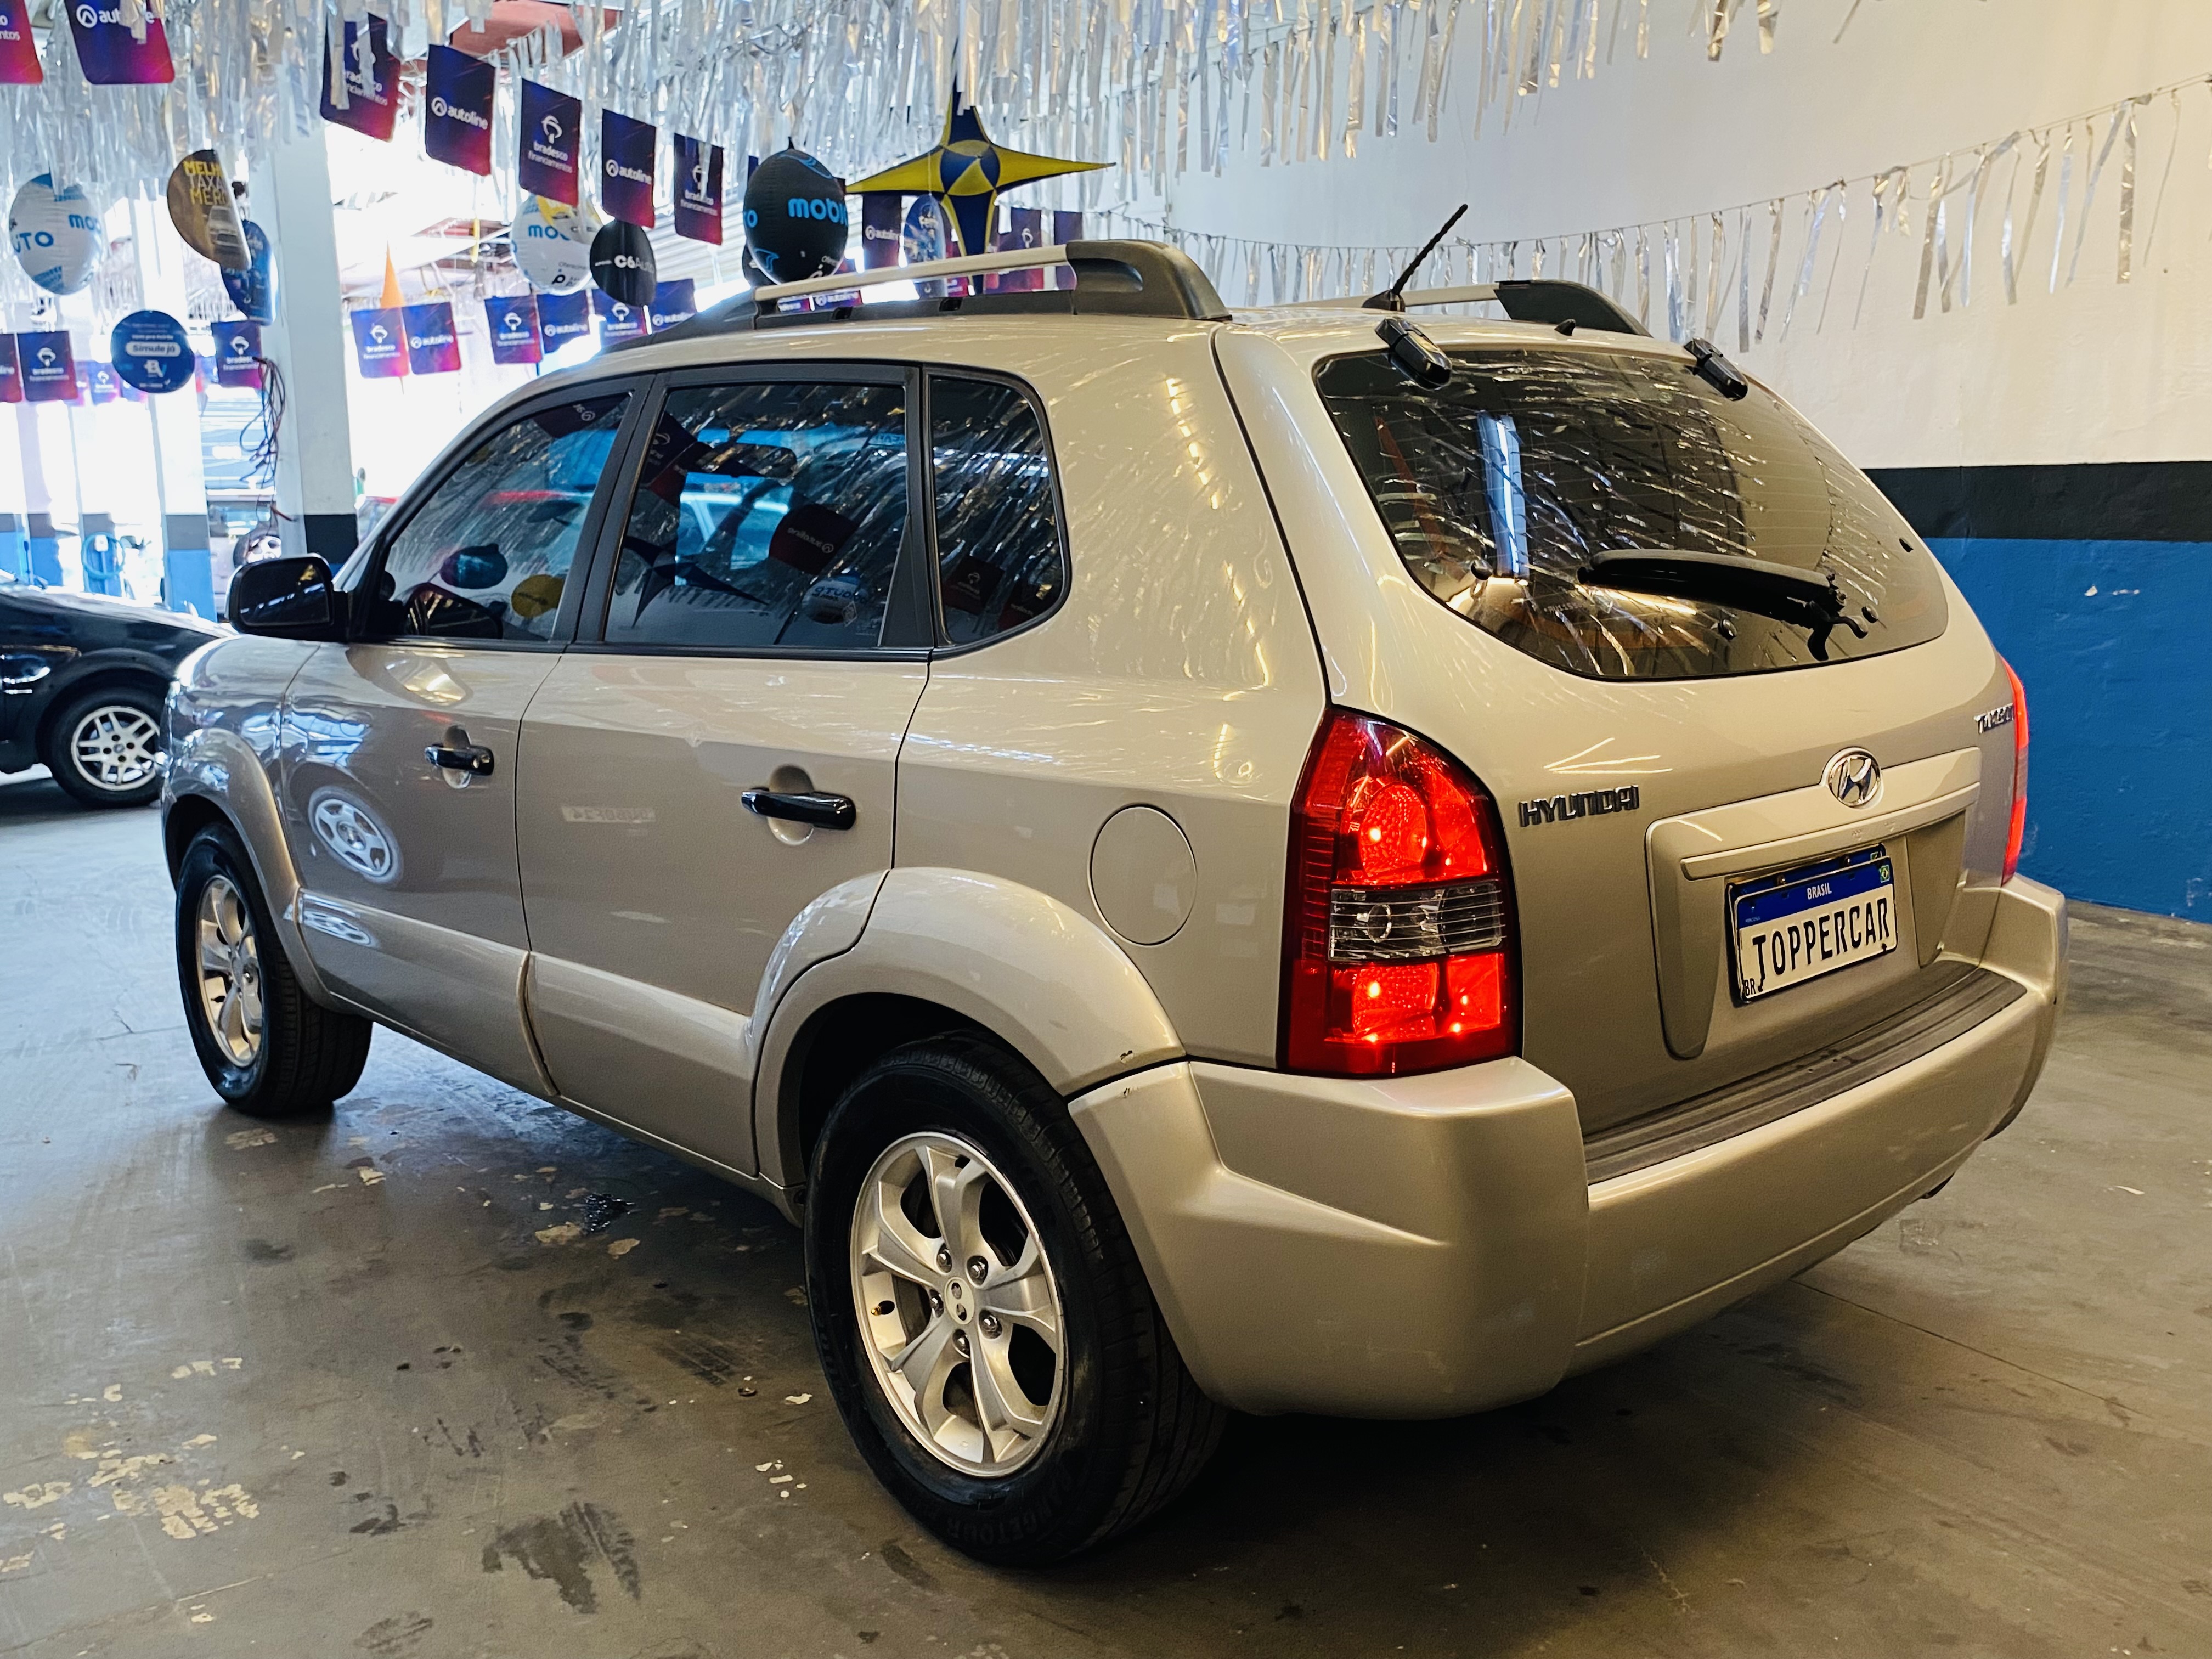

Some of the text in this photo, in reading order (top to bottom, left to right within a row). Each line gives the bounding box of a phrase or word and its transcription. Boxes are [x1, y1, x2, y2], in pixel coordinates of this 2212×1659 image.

[447, 106, 488, 130] autoline
[533, 140, 568, 161] bradesco
[619, 166, 652, 185] autoline
[1519, 784, 1640, 827] HYUNDAI
[1807, 882, 1832, 900] BRASIL
[1752, 897, 1890, 982] TOPPERCAR
[1743, 978, 1756, 997] BR
